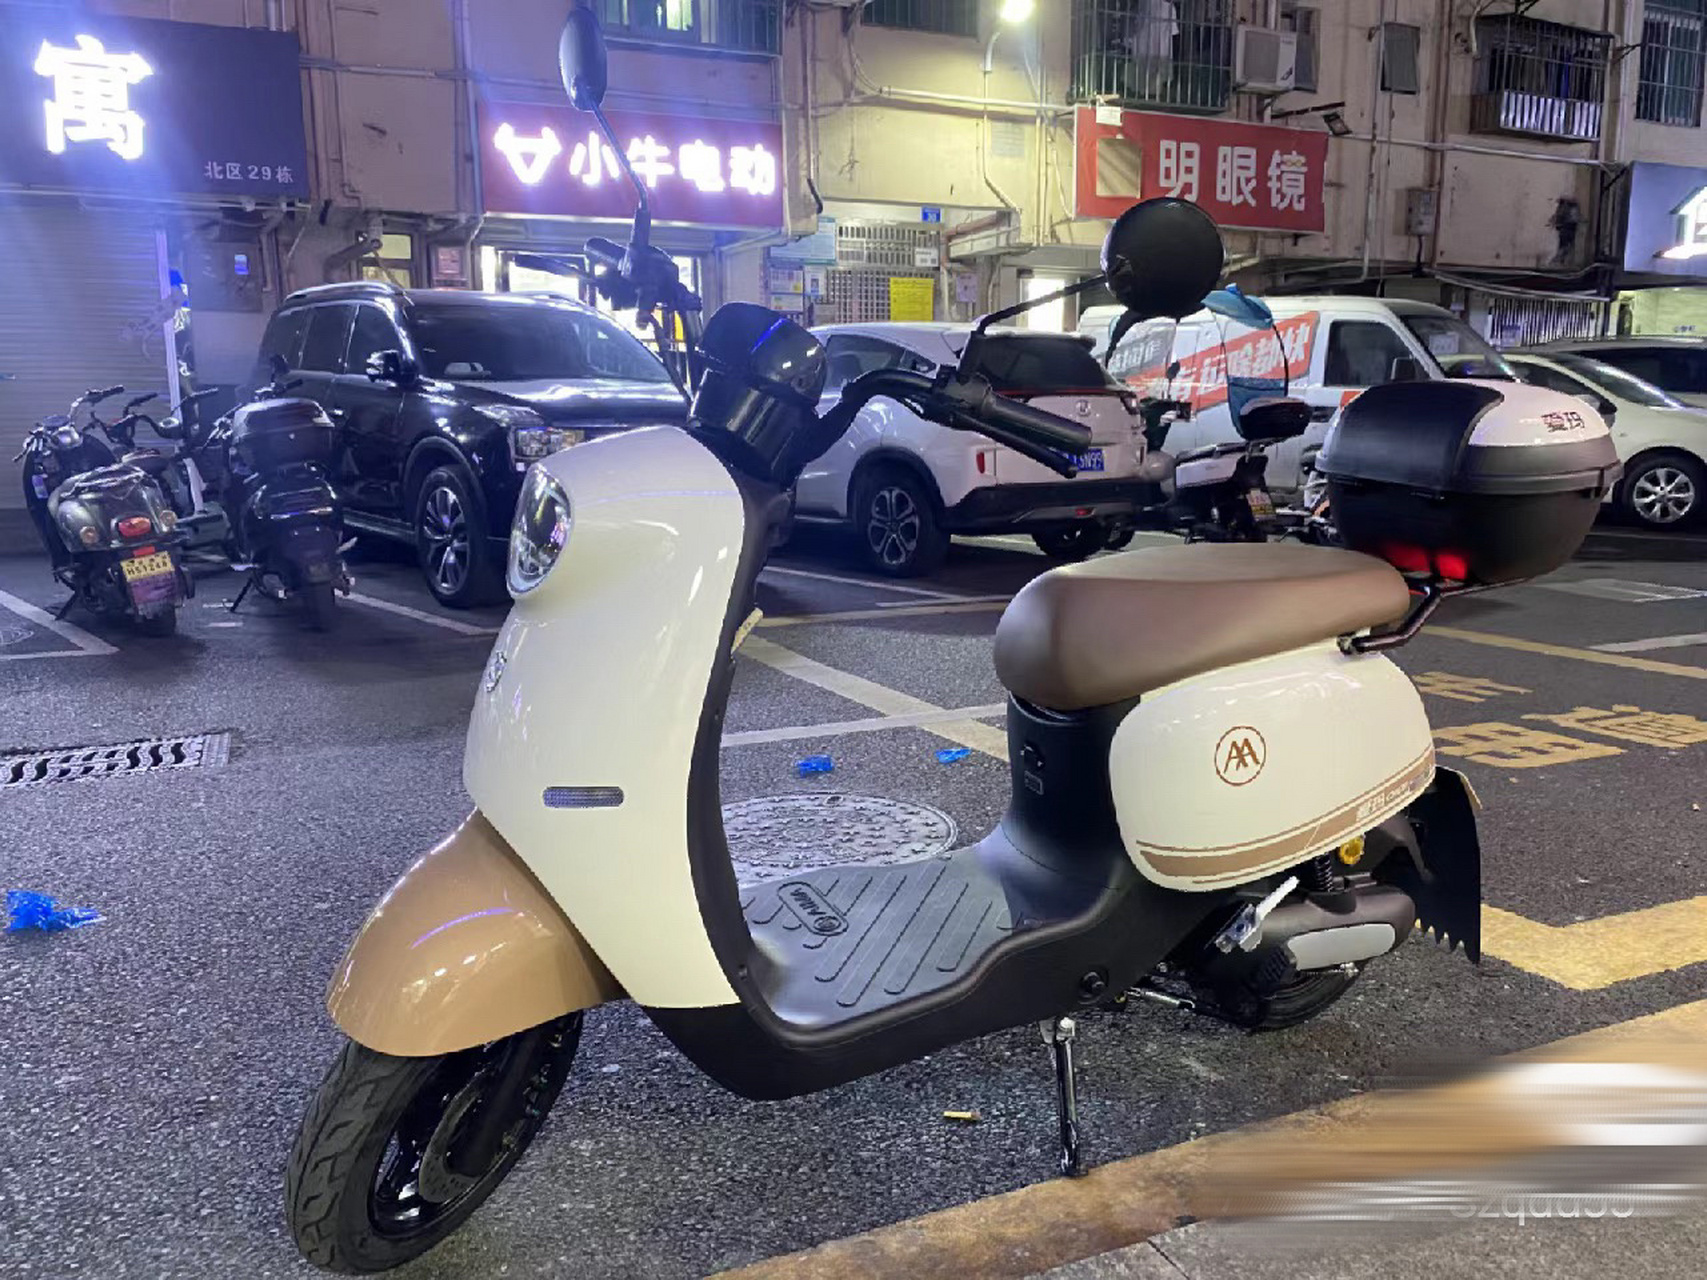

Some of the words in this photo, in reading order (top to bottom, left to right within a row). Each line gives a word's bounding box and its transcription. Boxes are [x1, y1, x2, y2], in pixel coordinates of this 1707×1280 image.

[33, 33, 154, 160] 寓
[203, 161, 294, 184] 北区29栋
[569, 127, 776, 196] 小牛电动
[1159, 139, 1308, 211] 明眼镜
